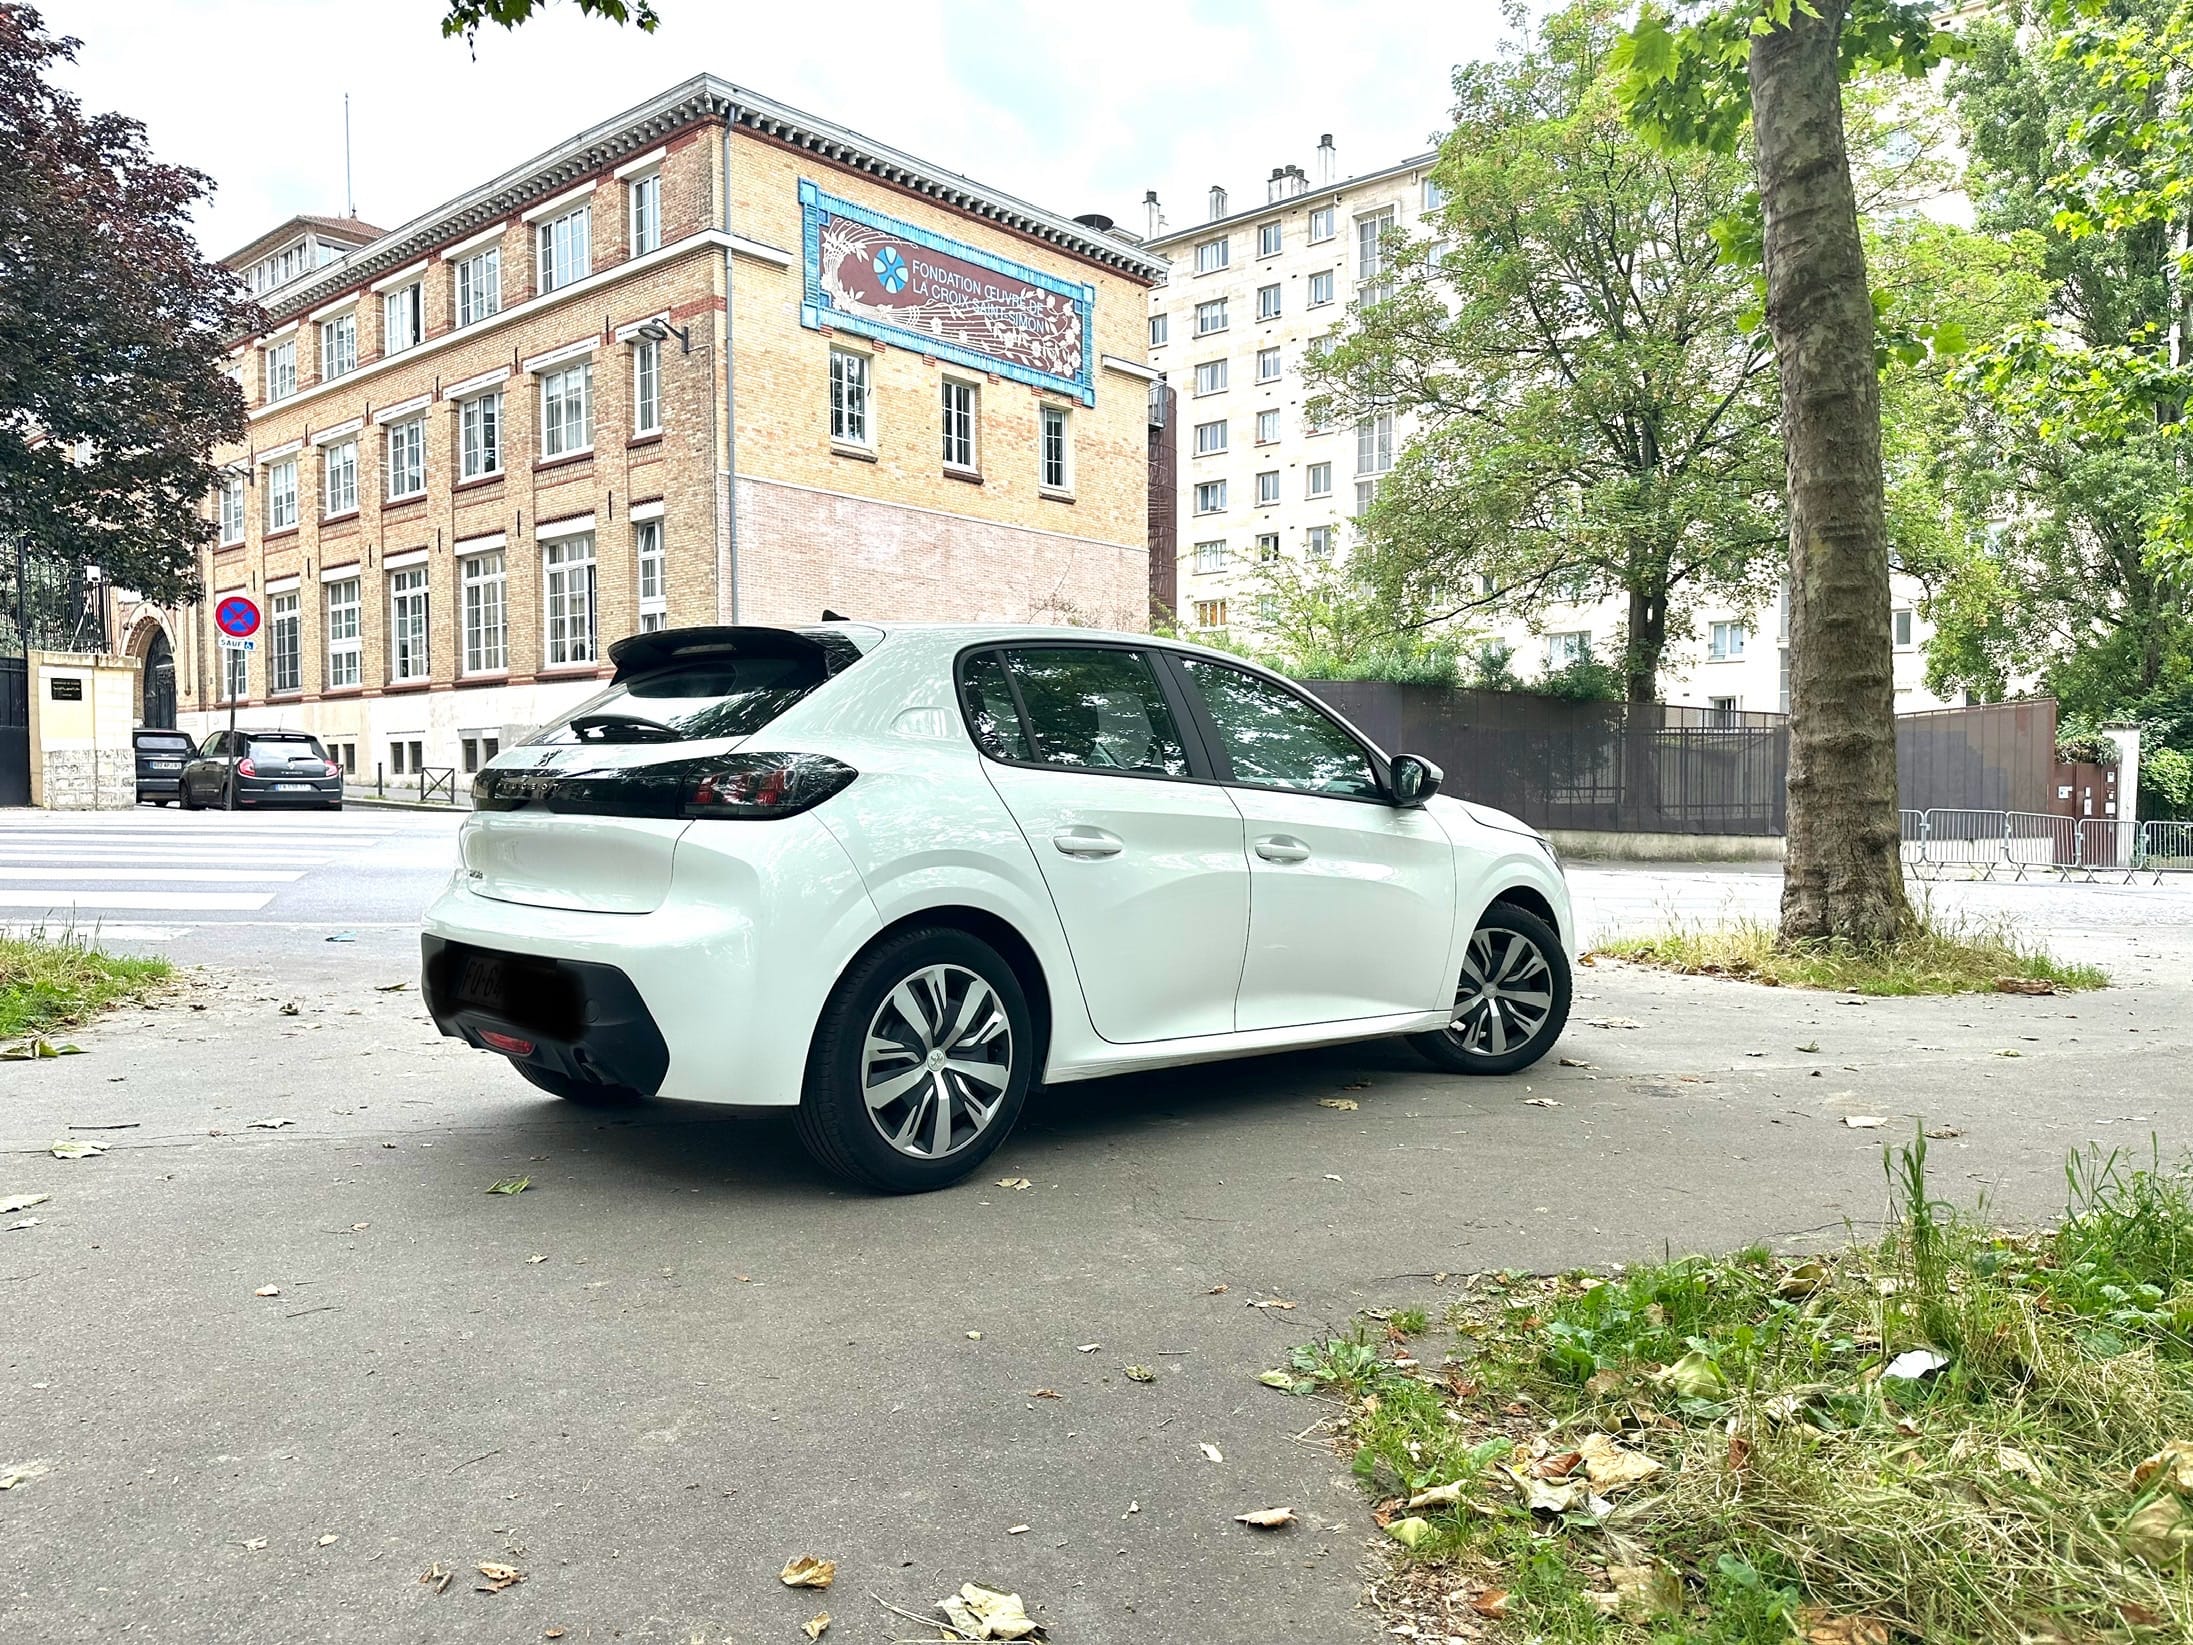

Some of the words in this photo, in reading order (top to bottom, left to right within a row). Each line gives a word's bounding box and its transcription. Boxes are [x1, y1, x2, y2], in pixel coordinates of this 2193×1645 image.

[912, 279, 928, 297] LA
[931, 284, 970, 307] CROIX
[913, 260, 981, 295] FONDATION
[1029, 300, 1044, 316] DE
[221, 639, 242, 648] SAUF
[495, 782, 560, 790] PEUGEOT
